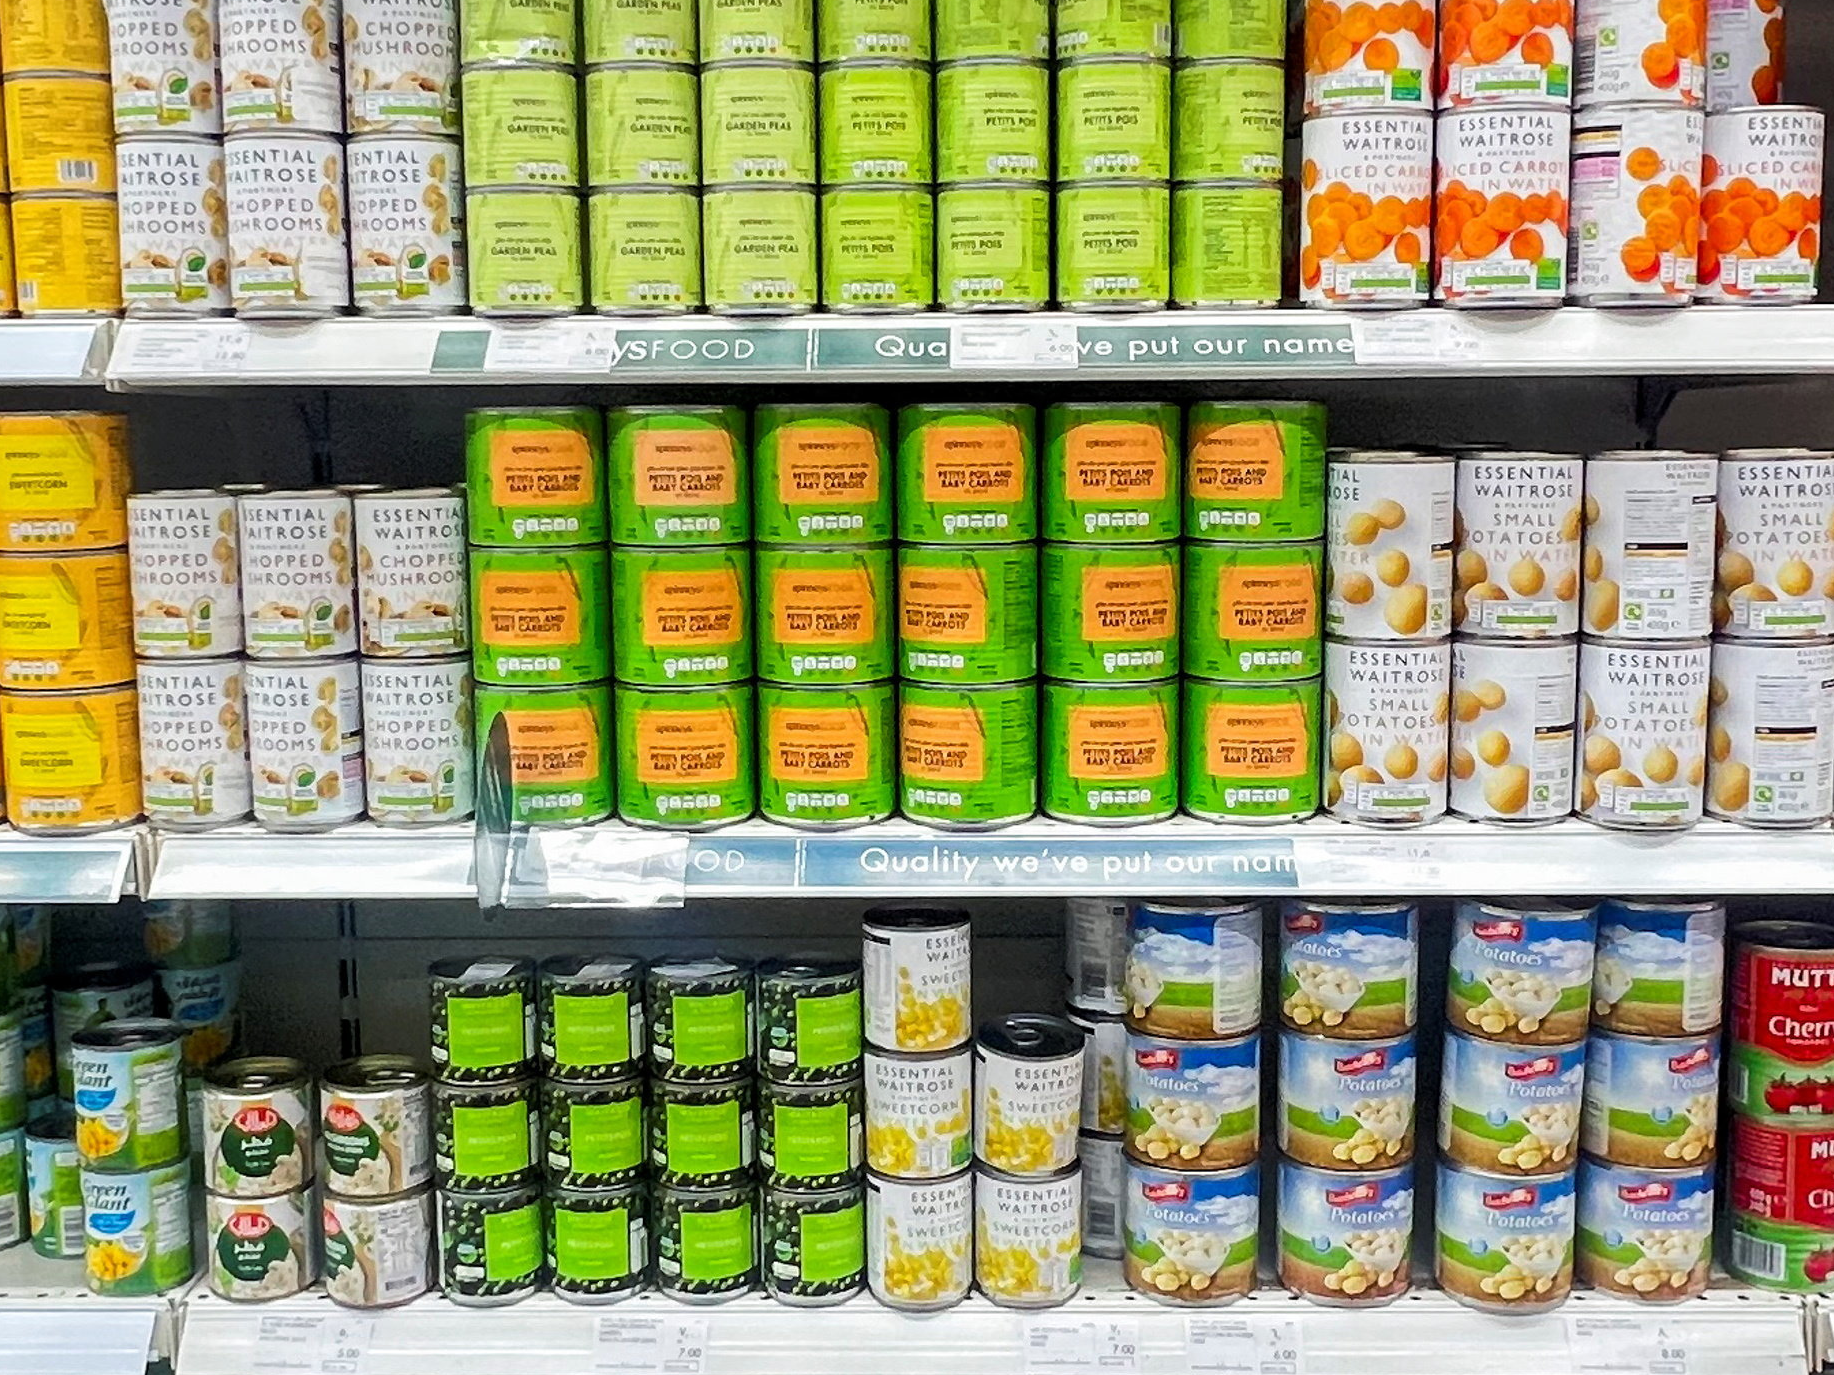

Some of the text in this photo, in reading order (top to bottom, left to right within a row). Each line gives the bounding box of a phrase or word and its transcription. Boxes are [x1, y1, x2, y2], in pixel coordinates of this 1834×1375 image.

[1458, 115, 1554, 132] ESSENTIAL
[1459, 132, 1554, 147] WAITROSE
[1129, 335, 1187, 361] put
[1194, 336, 1252, 356] our
[1263, 336, 1354, 356] name
[1474, 465, 1574, 482] ESSENTIAL
[1475, 483, 1574, 499] WAITROSE
[1493, 511, 1557, 528] SMALL
[1607, 652, 1705, 668] ESSENTIAL
[1608, 670, 1705, 686] WAITROSE
[1627, 698, 1690, 715] SMALL
[860, 846, 1222, 883] Quality we've put our
[1475, 942, 1544, 968] Potatoes
[874, 1063, 954, 1079] ESSENTIAL
[877, 1078, 955, 1093] WAITROSE
